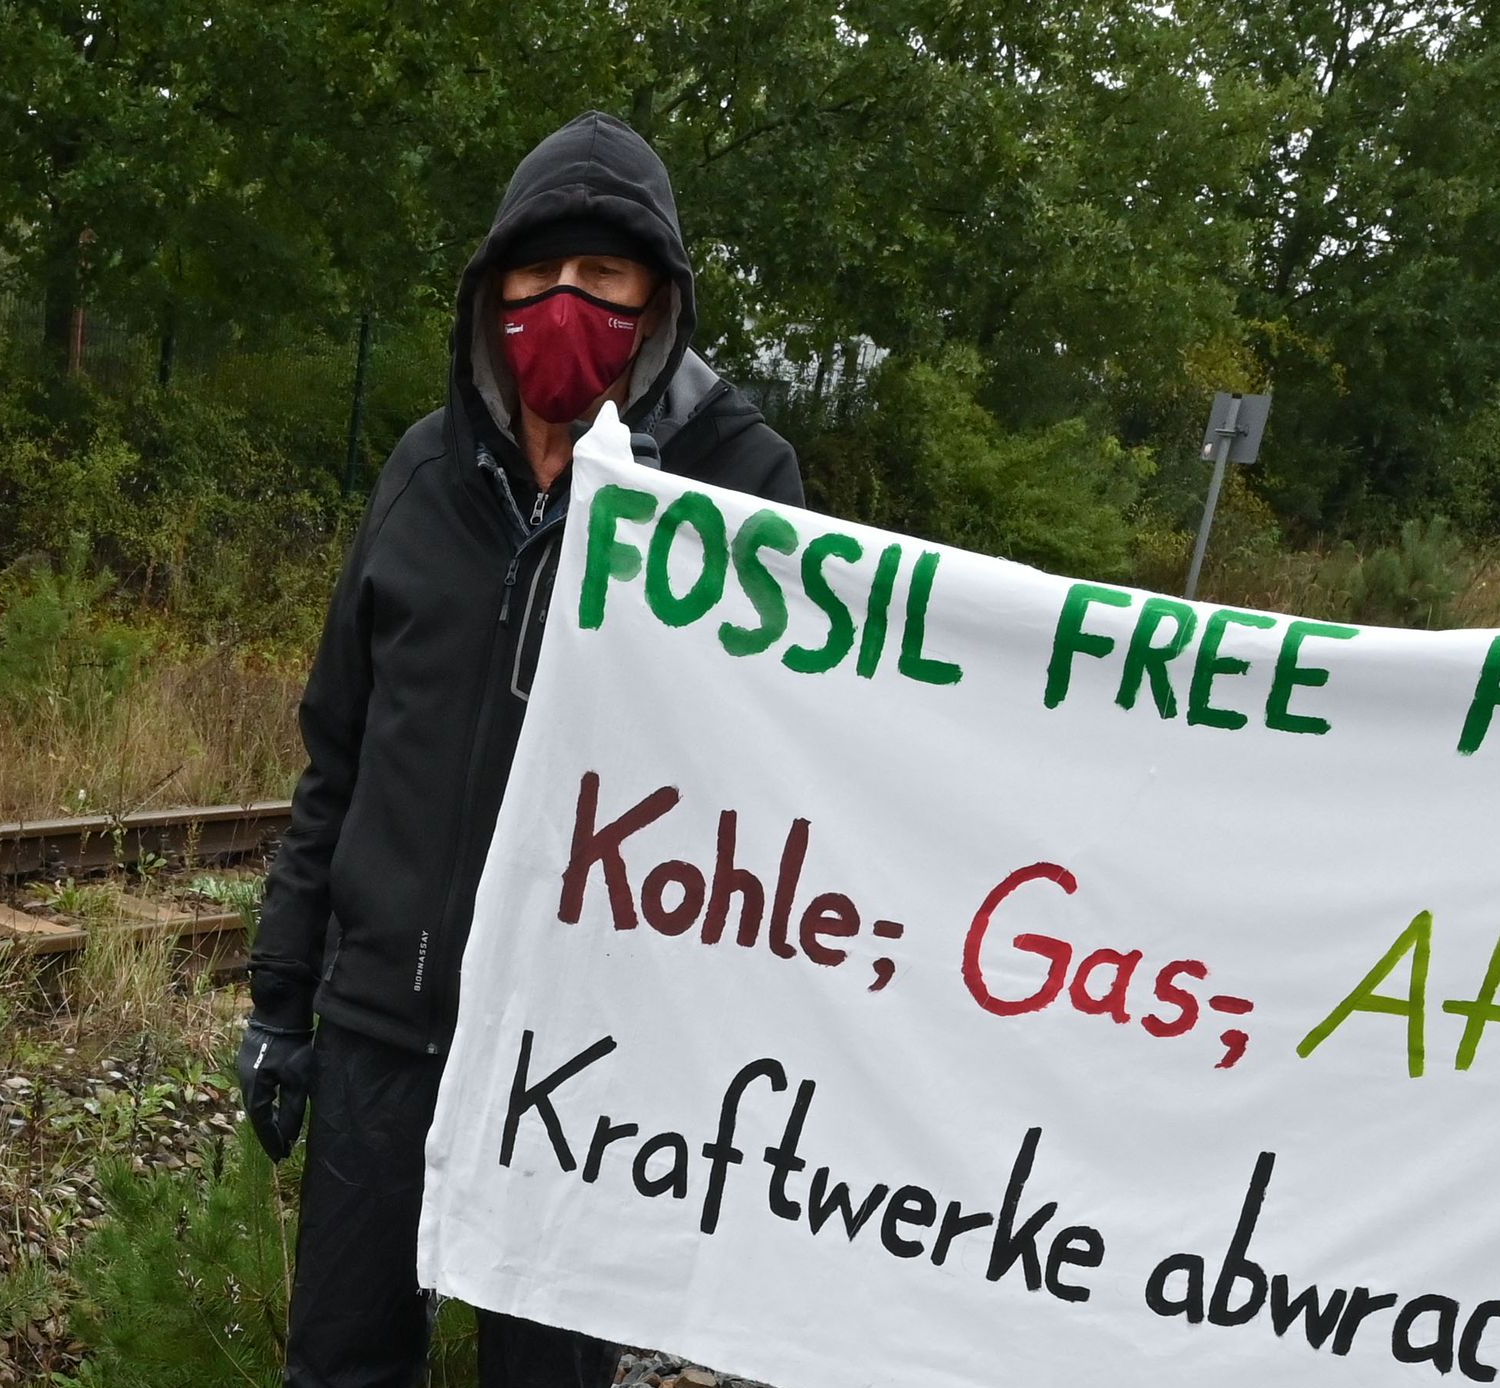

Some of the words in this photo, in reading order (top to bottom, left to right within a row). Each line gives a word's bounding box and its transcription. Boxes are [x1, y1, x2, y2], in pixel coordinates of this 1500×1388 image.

[579, 485, 963, 685] FOSSIL
[1044, 584, 1358, 735] FREE
[500, 1029, 1105, 1303] Kraftwerke
